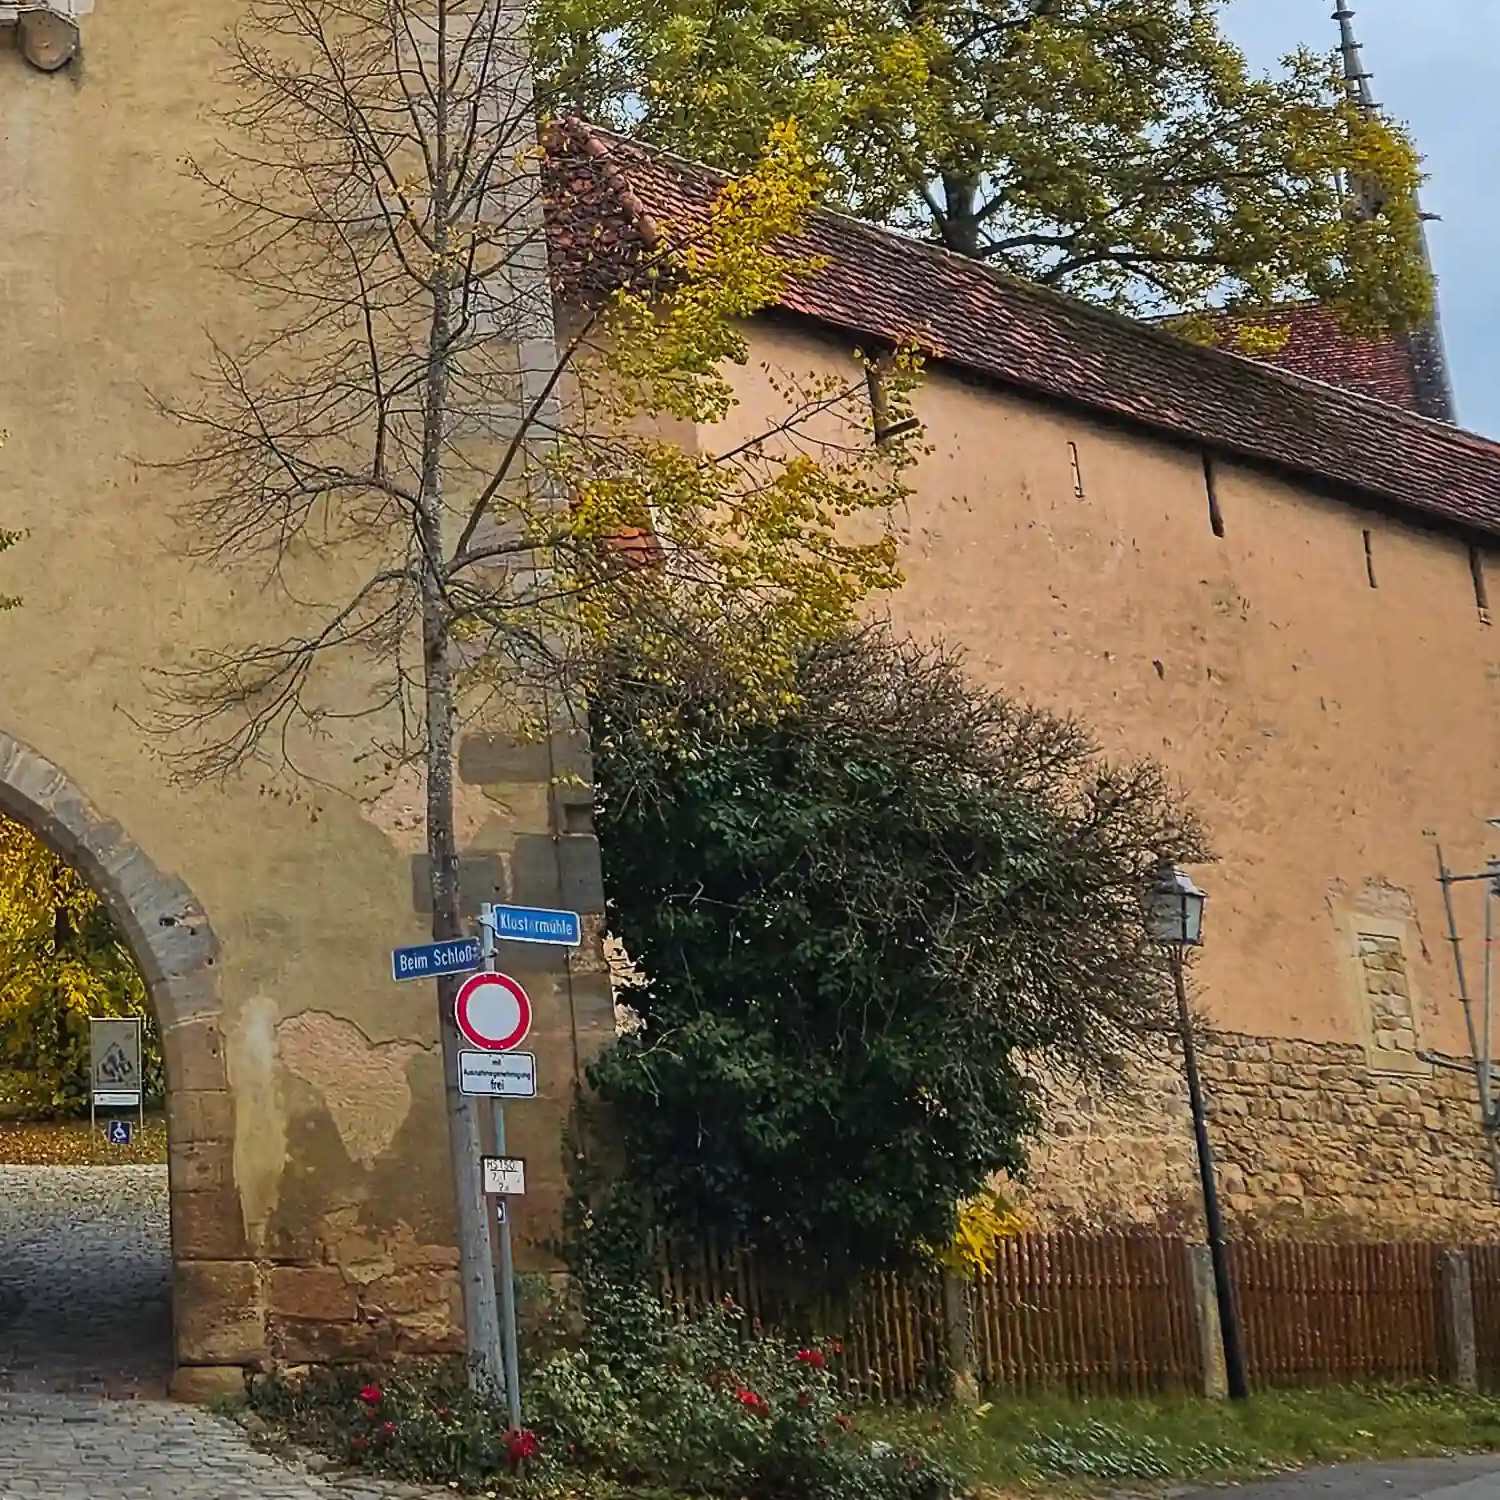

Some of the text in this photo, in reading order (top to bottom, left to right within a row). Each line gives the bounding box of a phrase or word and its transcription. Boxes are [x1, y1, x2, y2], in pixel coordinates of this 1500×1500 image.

[400, 945, 472, 971] Beim Schloß
[491, 1078, 504, 1091] frei
